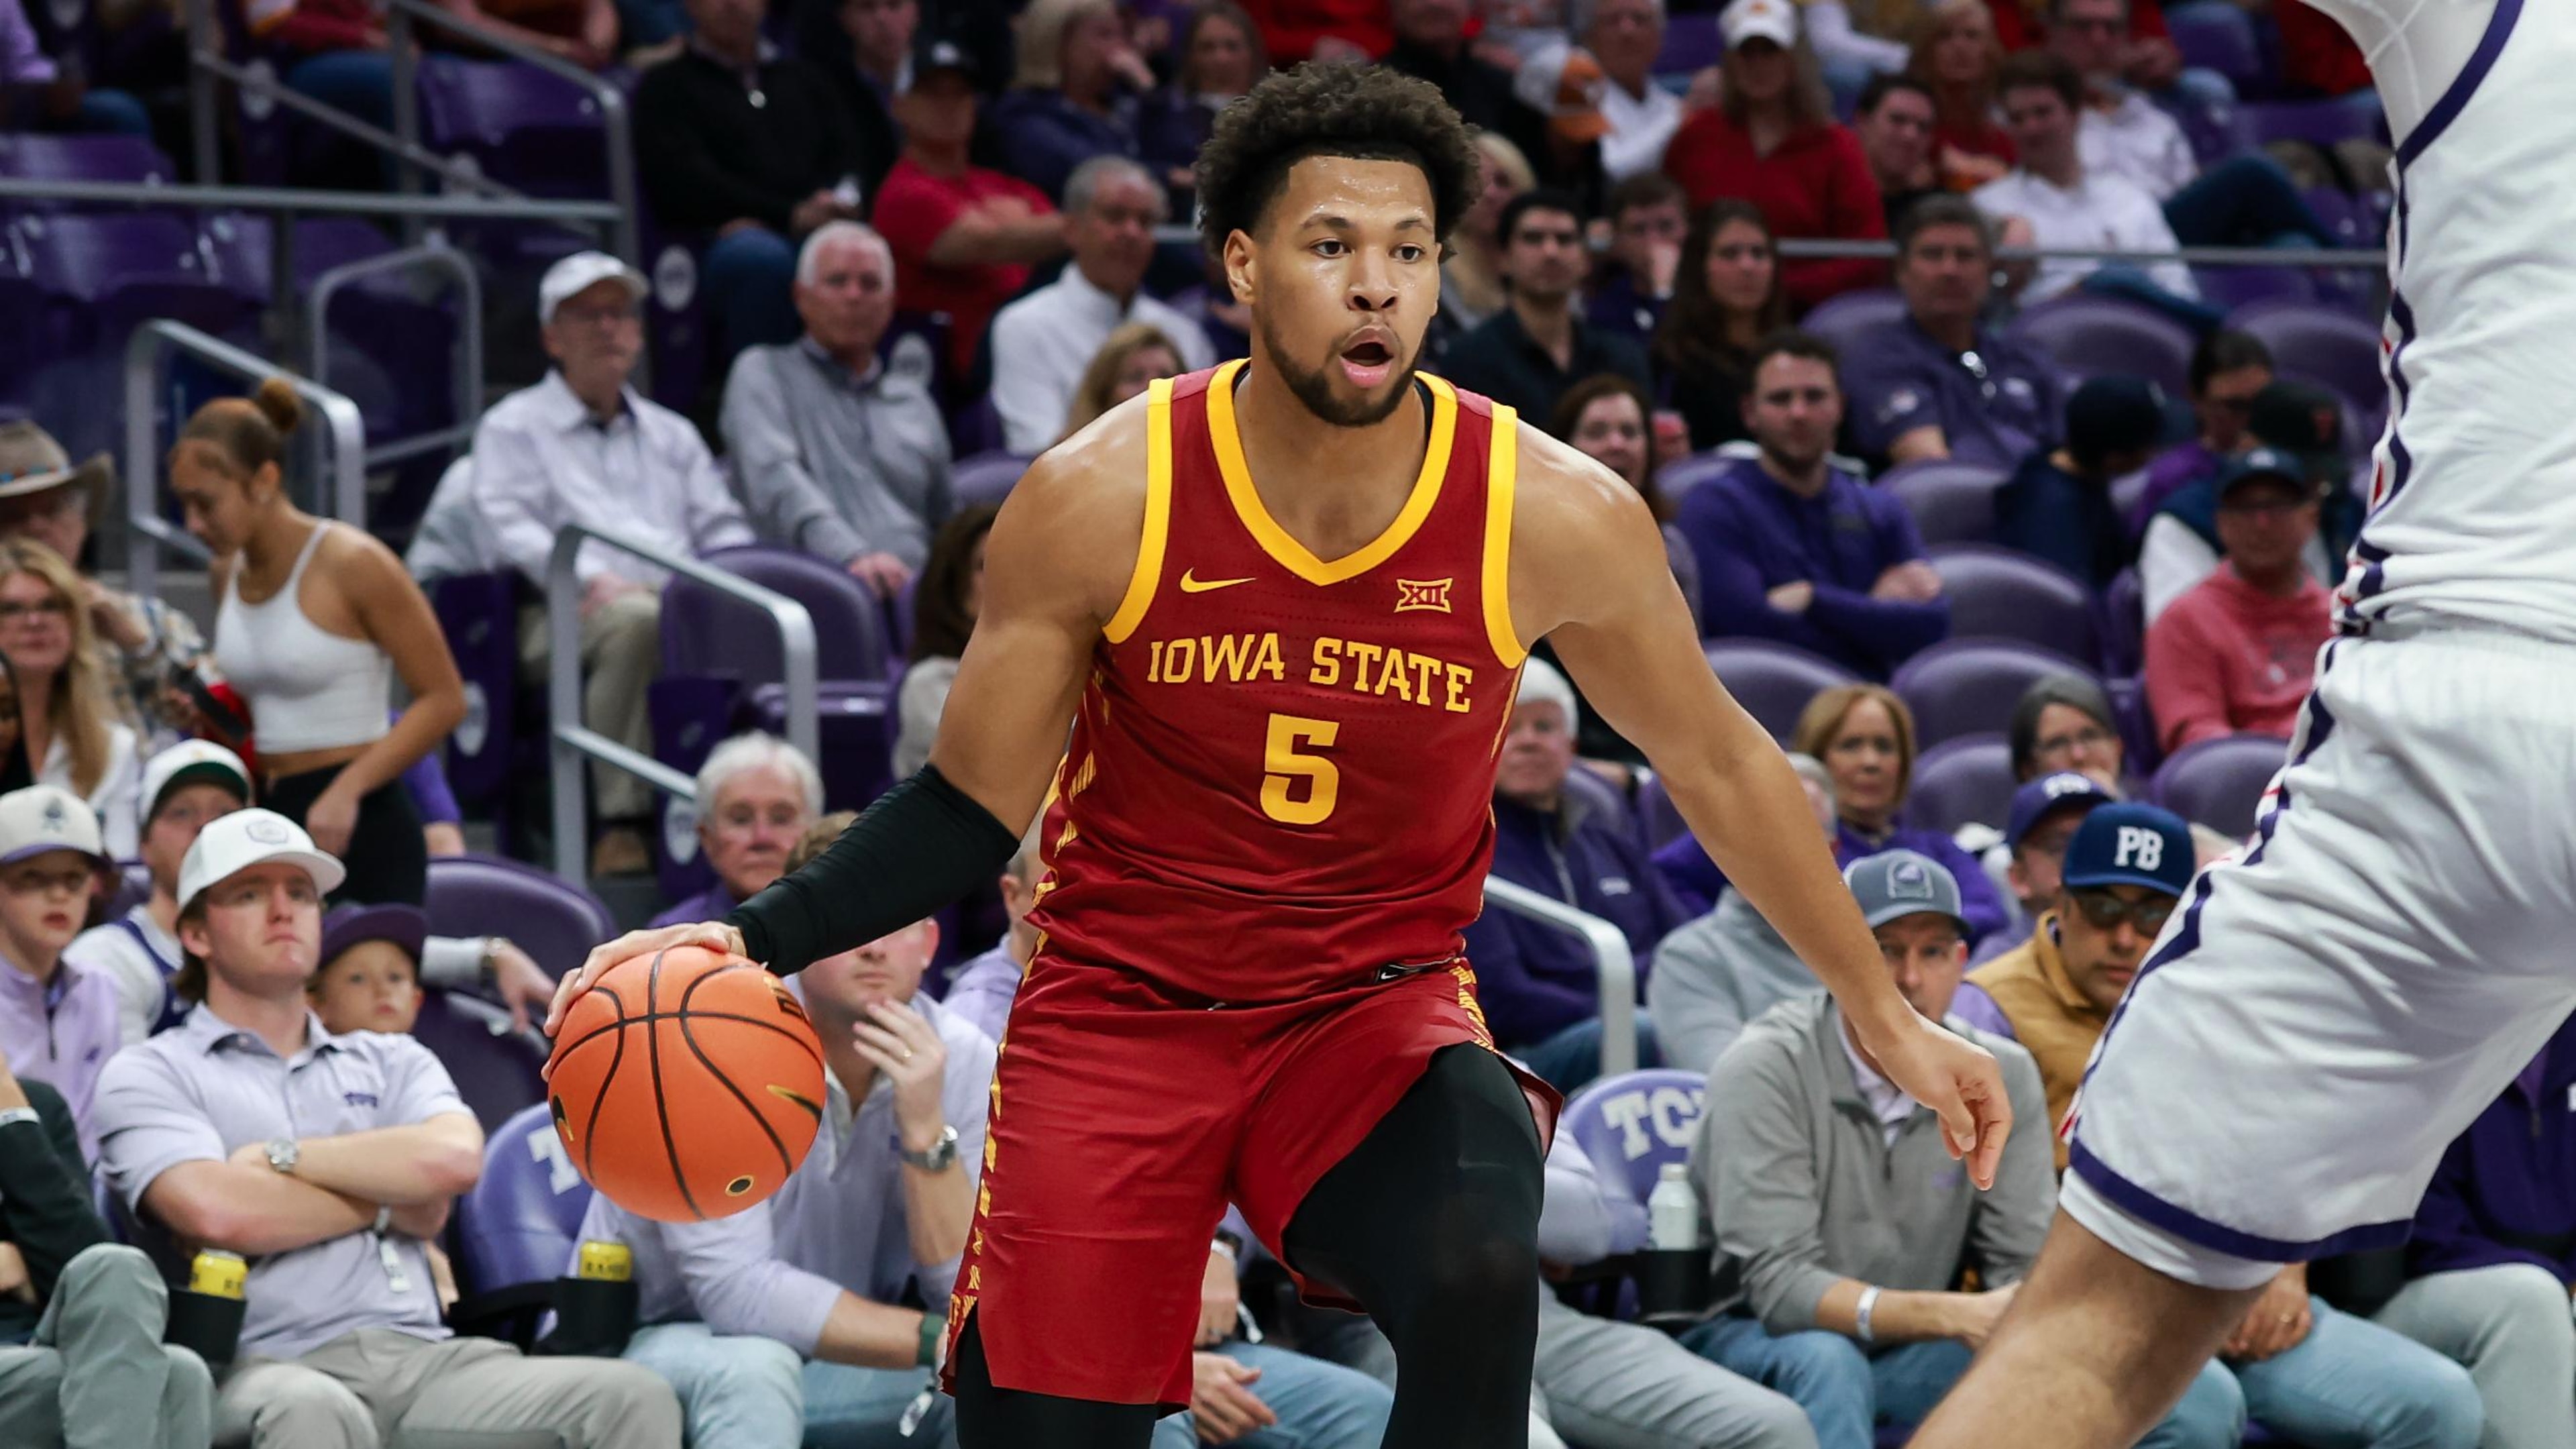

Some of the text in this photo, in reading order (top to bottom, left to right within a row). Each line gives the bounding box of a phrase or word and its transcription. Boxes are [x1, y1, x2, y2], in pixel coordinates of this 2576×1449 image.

[1148, 633, 1472, 712] IOWA STATE
[1260, 713, 1339, 824] 5
[2114, 826, 2163, 871] PB
[1601, 1087, 1705, 1162] TC
